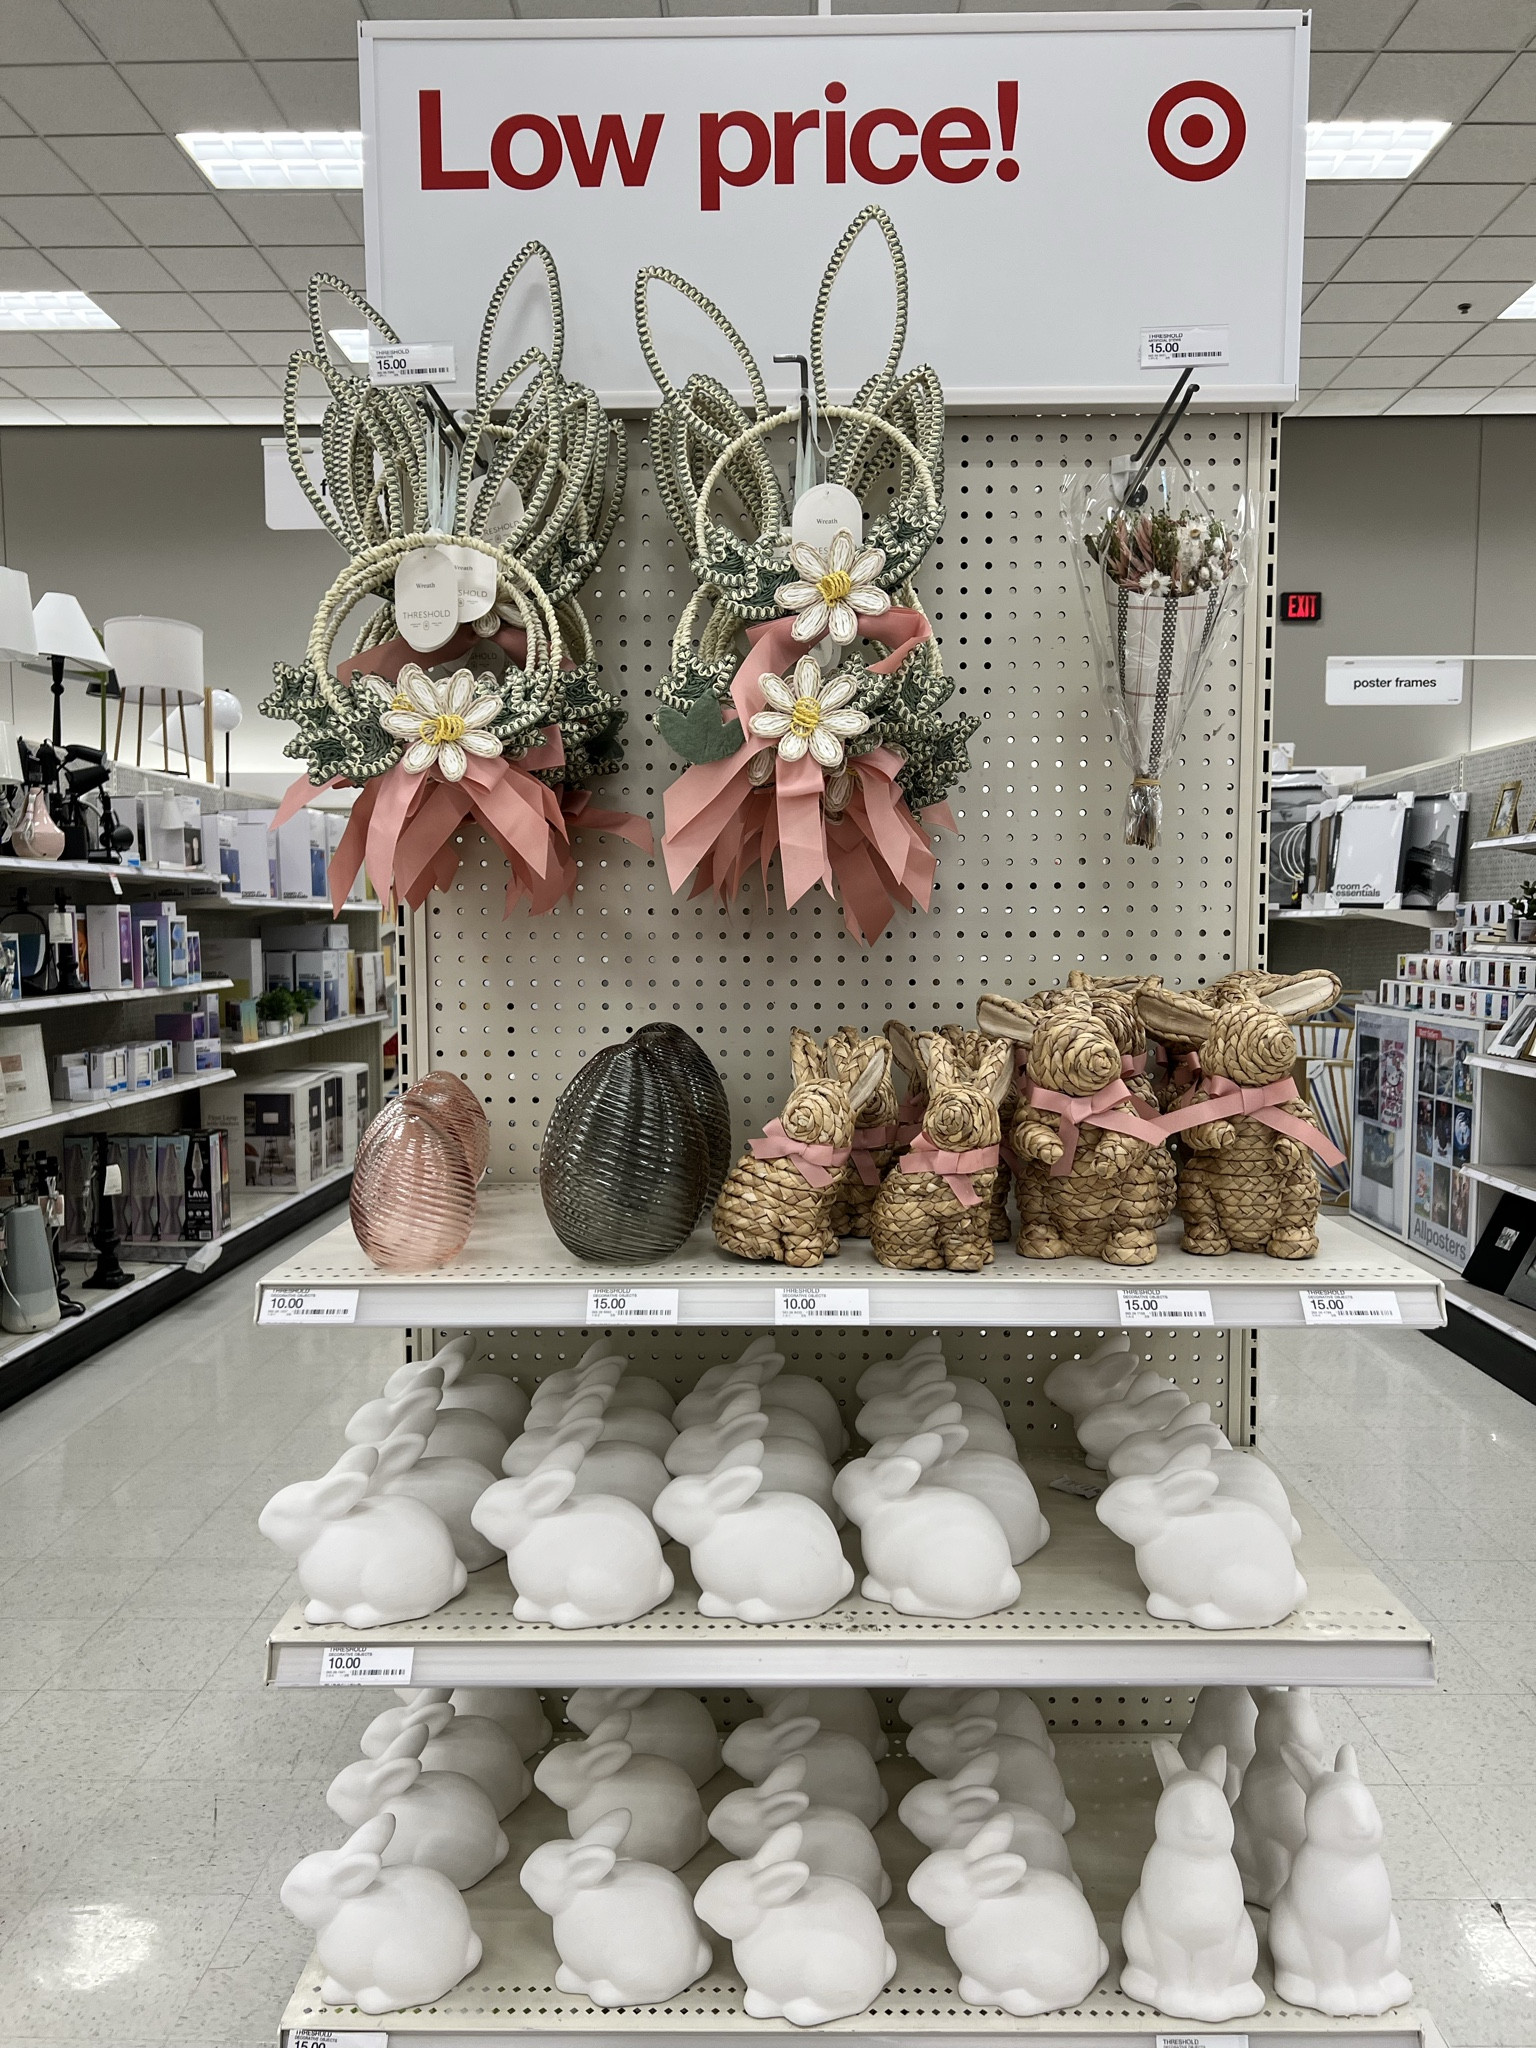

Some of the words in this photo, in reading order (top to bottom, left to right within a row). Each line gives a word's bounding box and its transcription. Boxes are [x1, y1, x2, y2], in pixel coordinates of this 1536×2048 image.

[419, 89, 665, 191] Low
[699, 80, 1020, 212] price!
[1149, 342, 1179, 353] 15.00
[377, 358, 407, 371] 15.00
[458, 590, 488, 598] SHOLD
[1287, 594, 1317, 618] EXIT
[402, 609, 451, 619] THRESHOLD
[1353, 678, 1392, 690] poster
[1395, 677, 1437, 688] frames
[1335, 888, 1381, 897] essentials
[187, 1190, 209, 1198] LAVA
[1413, 1218, 1467, 1261] Allposters
[271, 1297, 304, 1309] 10.00
[593, 1298, 626, 1309] 15.00
[783, 1298, 816, 1310] 10.00
[1124, 1299, 1158, 1310] 15.00
[1310, 1299, 1344, 1310] 15.00
[328, 1657, 361, 1669] 10.00
[295, 2030, 333, 2038] THRESHOLD
